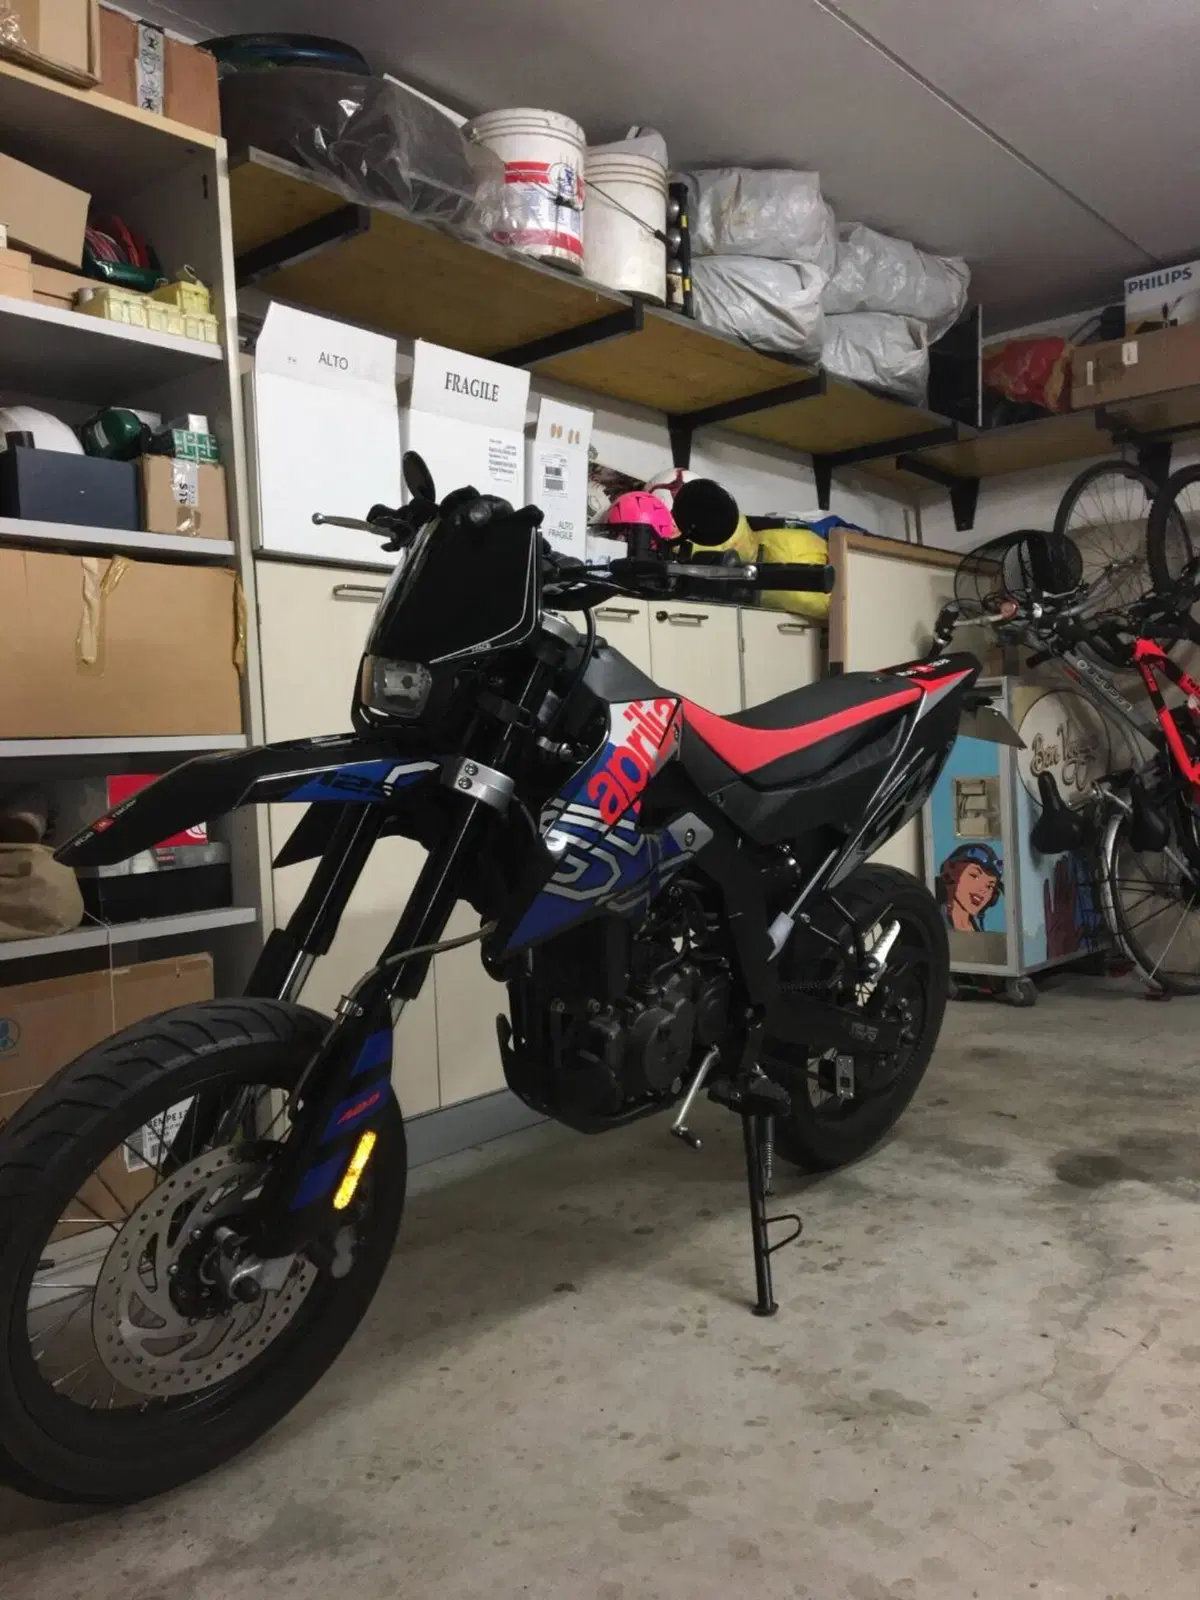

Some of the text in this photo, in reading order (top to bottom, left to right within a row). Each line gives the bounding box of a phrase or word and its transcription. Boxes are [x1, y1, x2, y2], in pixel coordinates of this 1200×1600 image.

[1128, 267, 1193, 294] PHILIPS
[318, 351, 348, 371] ALTO
[444, 371, 500, 402] FRAGILE
[548, 528, 574, 541] FRAGILE
[559, 520, 574, 530] ALTO
